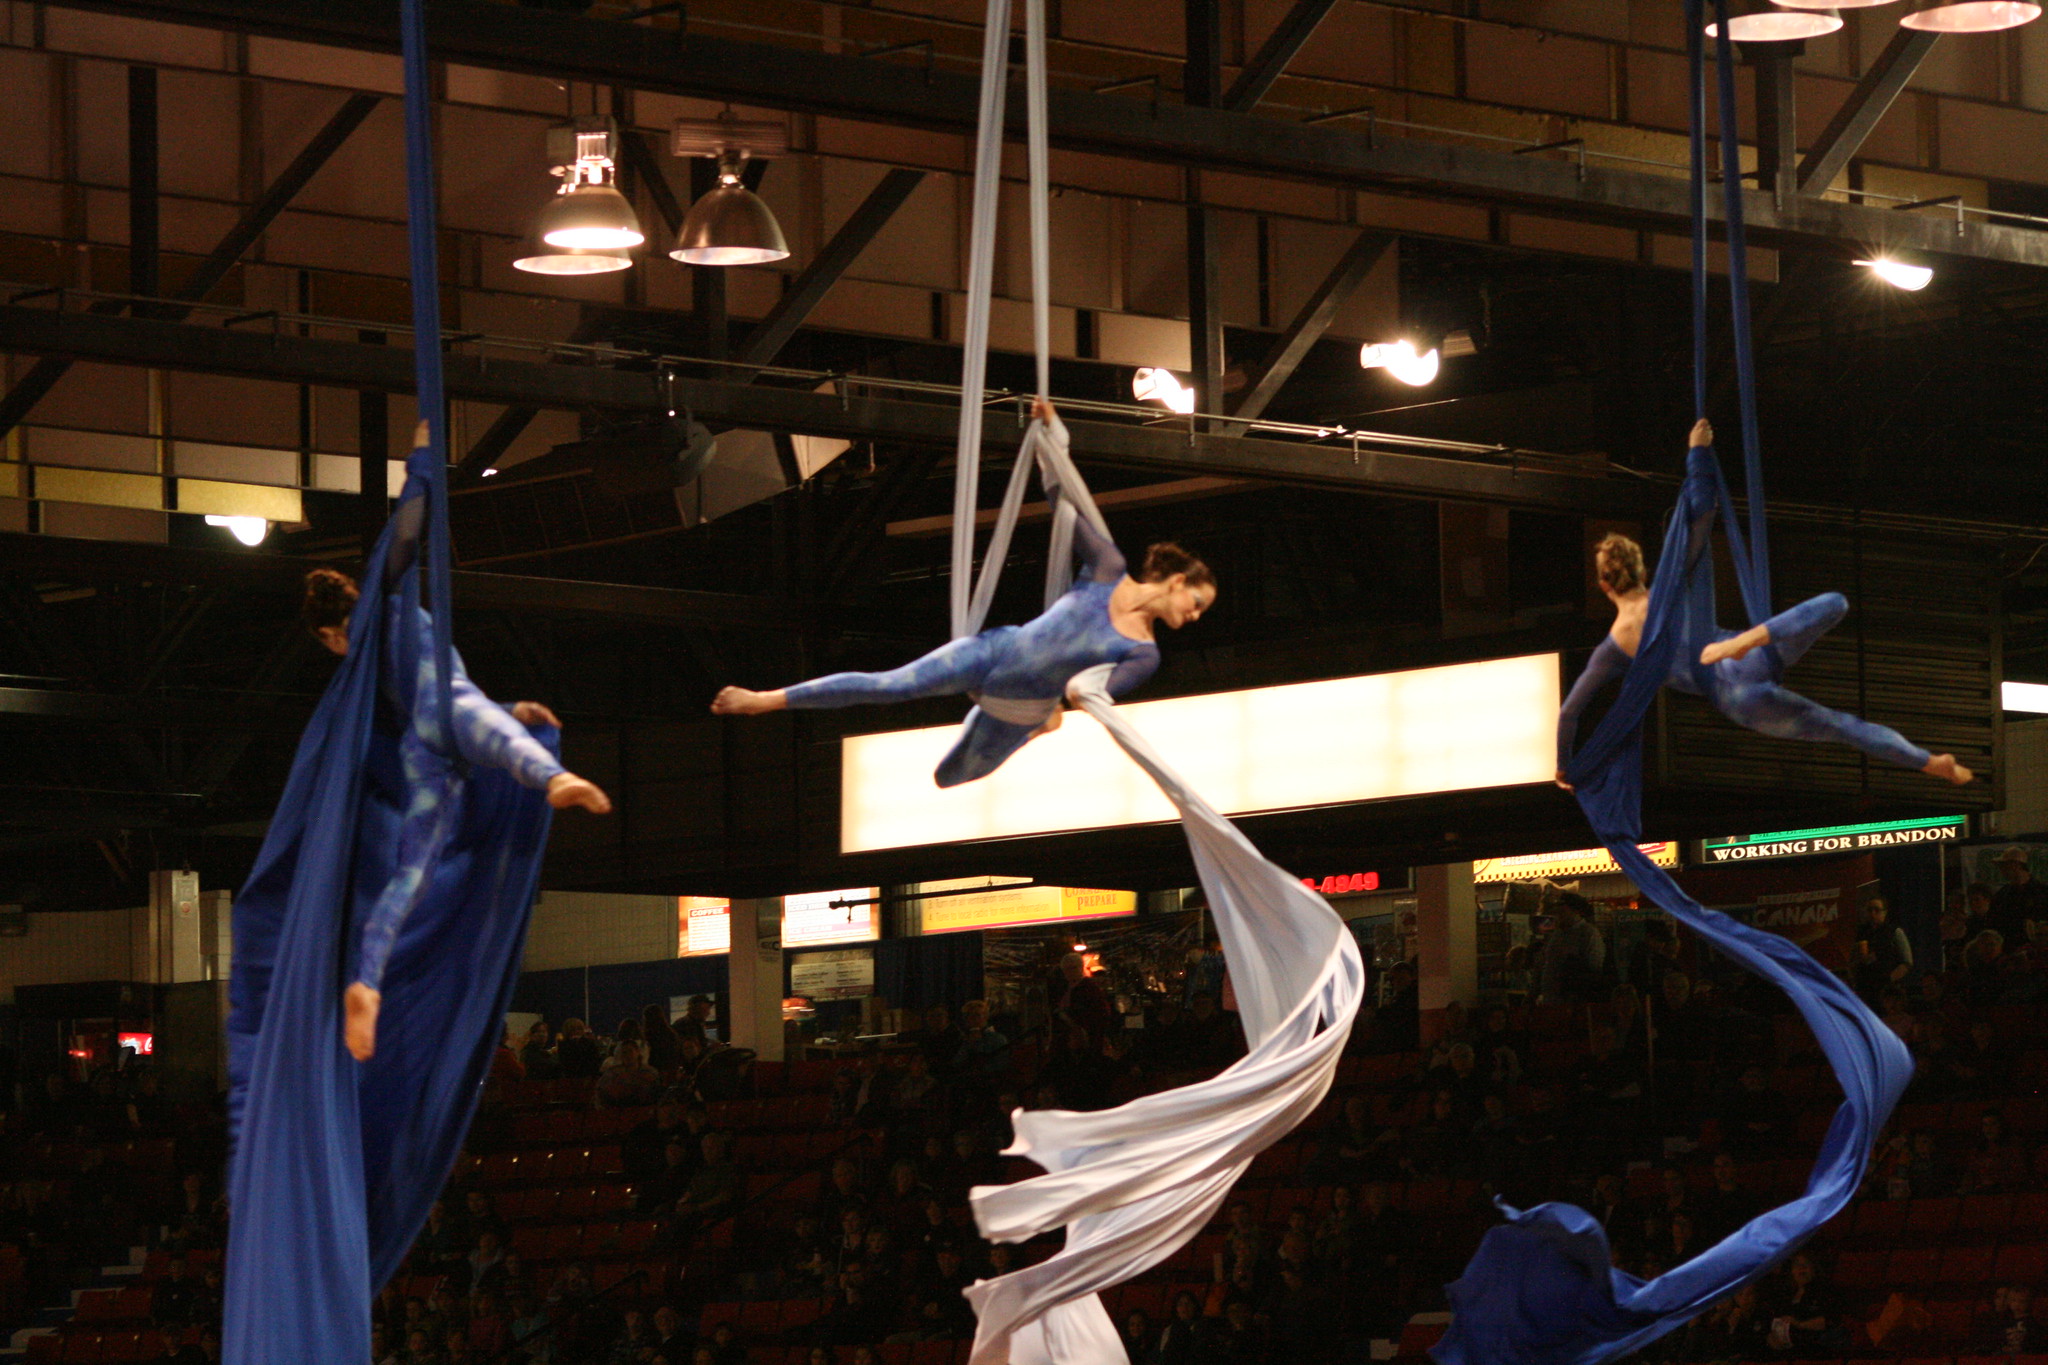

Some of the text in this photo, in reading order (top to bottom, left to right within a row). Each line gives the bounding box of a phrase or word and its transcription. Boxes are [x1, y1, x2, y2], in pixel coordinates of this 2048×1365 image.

[1713, 841, 1807, 861] WORKING
[1813, 836, 1853, 852] FOR
[1858, 827, 1956, 847] BRANDON
[691, 907, 724, 917] COFFEE
[1077, 893, 1117, 911] PREPARE
[1753, 902, 1838, 927] CANADA
